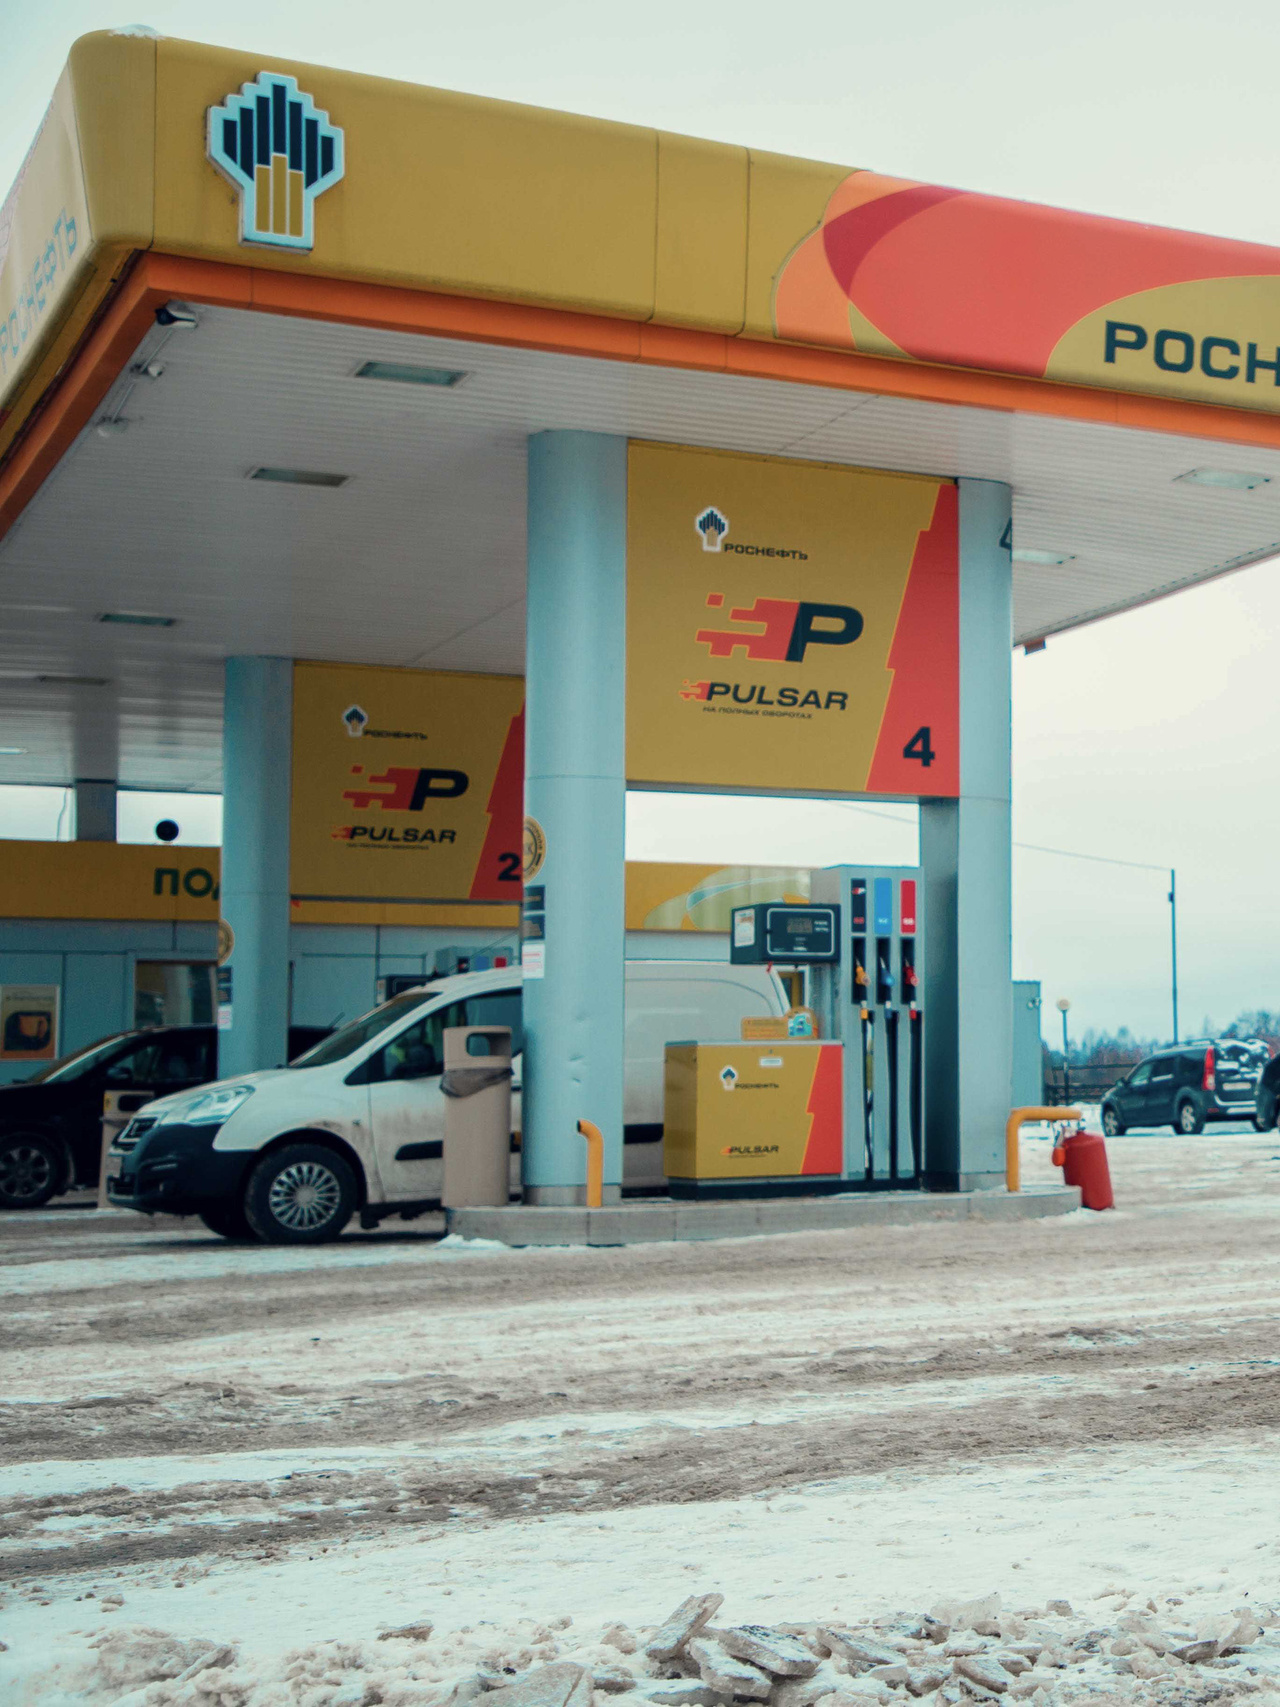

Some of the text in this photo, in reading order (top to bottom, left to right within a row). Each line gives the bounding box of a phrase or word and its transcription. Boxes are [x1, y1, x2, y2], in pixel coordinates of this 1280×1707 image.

[724, 543, 808, 560] РОСНЕФТЬ
[707, 682, 849, 711] PULSAR
[903, 726, 935, 767] 4
[349, 826, 457, 843] PULSAR
[497, 853, 521, 882] 2
